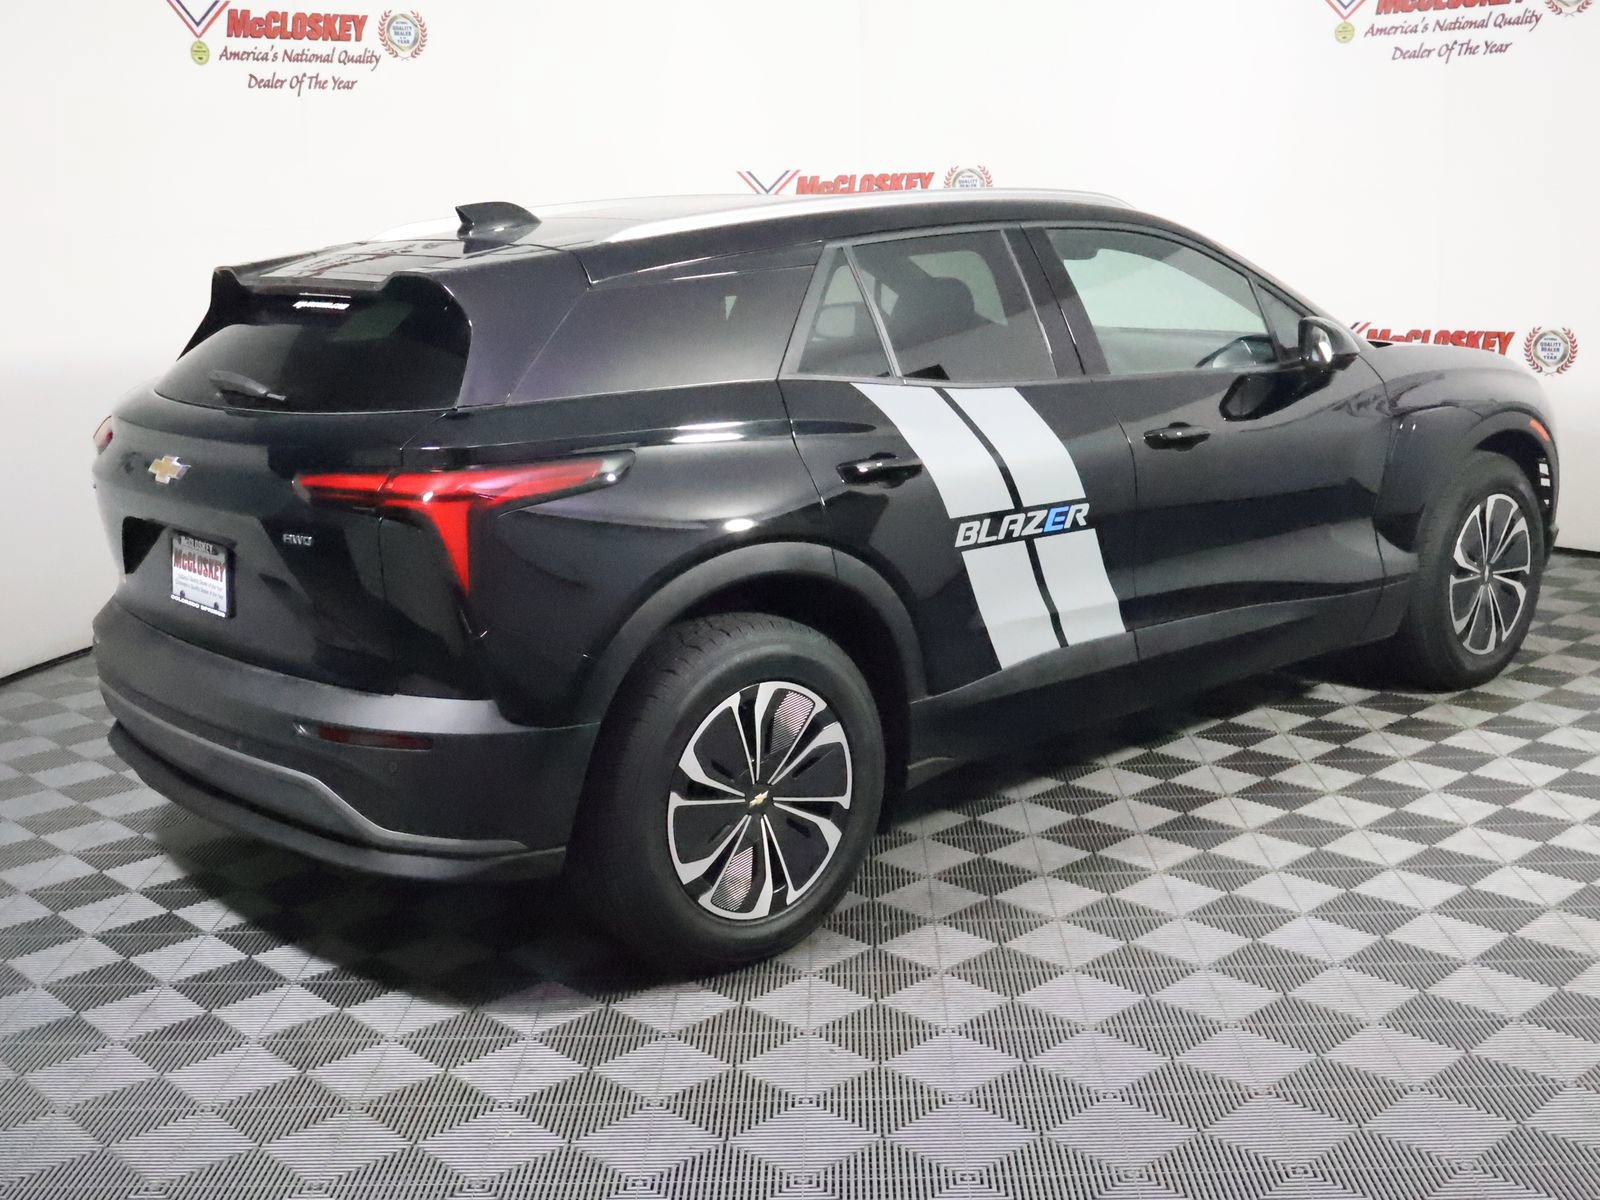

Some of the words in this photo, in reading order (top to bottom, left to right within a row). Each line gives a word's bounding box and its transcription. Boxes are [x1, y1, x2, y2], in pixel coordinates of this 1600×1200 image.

[227, 9, 368, 42] McCLOSKEY
[1364, 17, 1429, 38] America's
[1433, 11, 1491, 33] National
[1493, 8, 1543, 32] Quality
[218, 45, 278, 63] America's
[282, 47, 334, 65] National
[338, 49, 382, 72] Quality
[1391, 46, 1435, 61] Dealer
[1437, 41, 1458, 64] Of
[1457, 40, 1480, 57] The
[1483, 40, 1513, 55] Year
[247, 73, 287, 90] Dealer
[289, 74, 308, 97] Of
[307, 75, 329, 91] The
[331, 76, 358, 91] Year
[1367, 329, 1516, 356] OSKEY
[954, 502, 1091, 548] BLAZER
